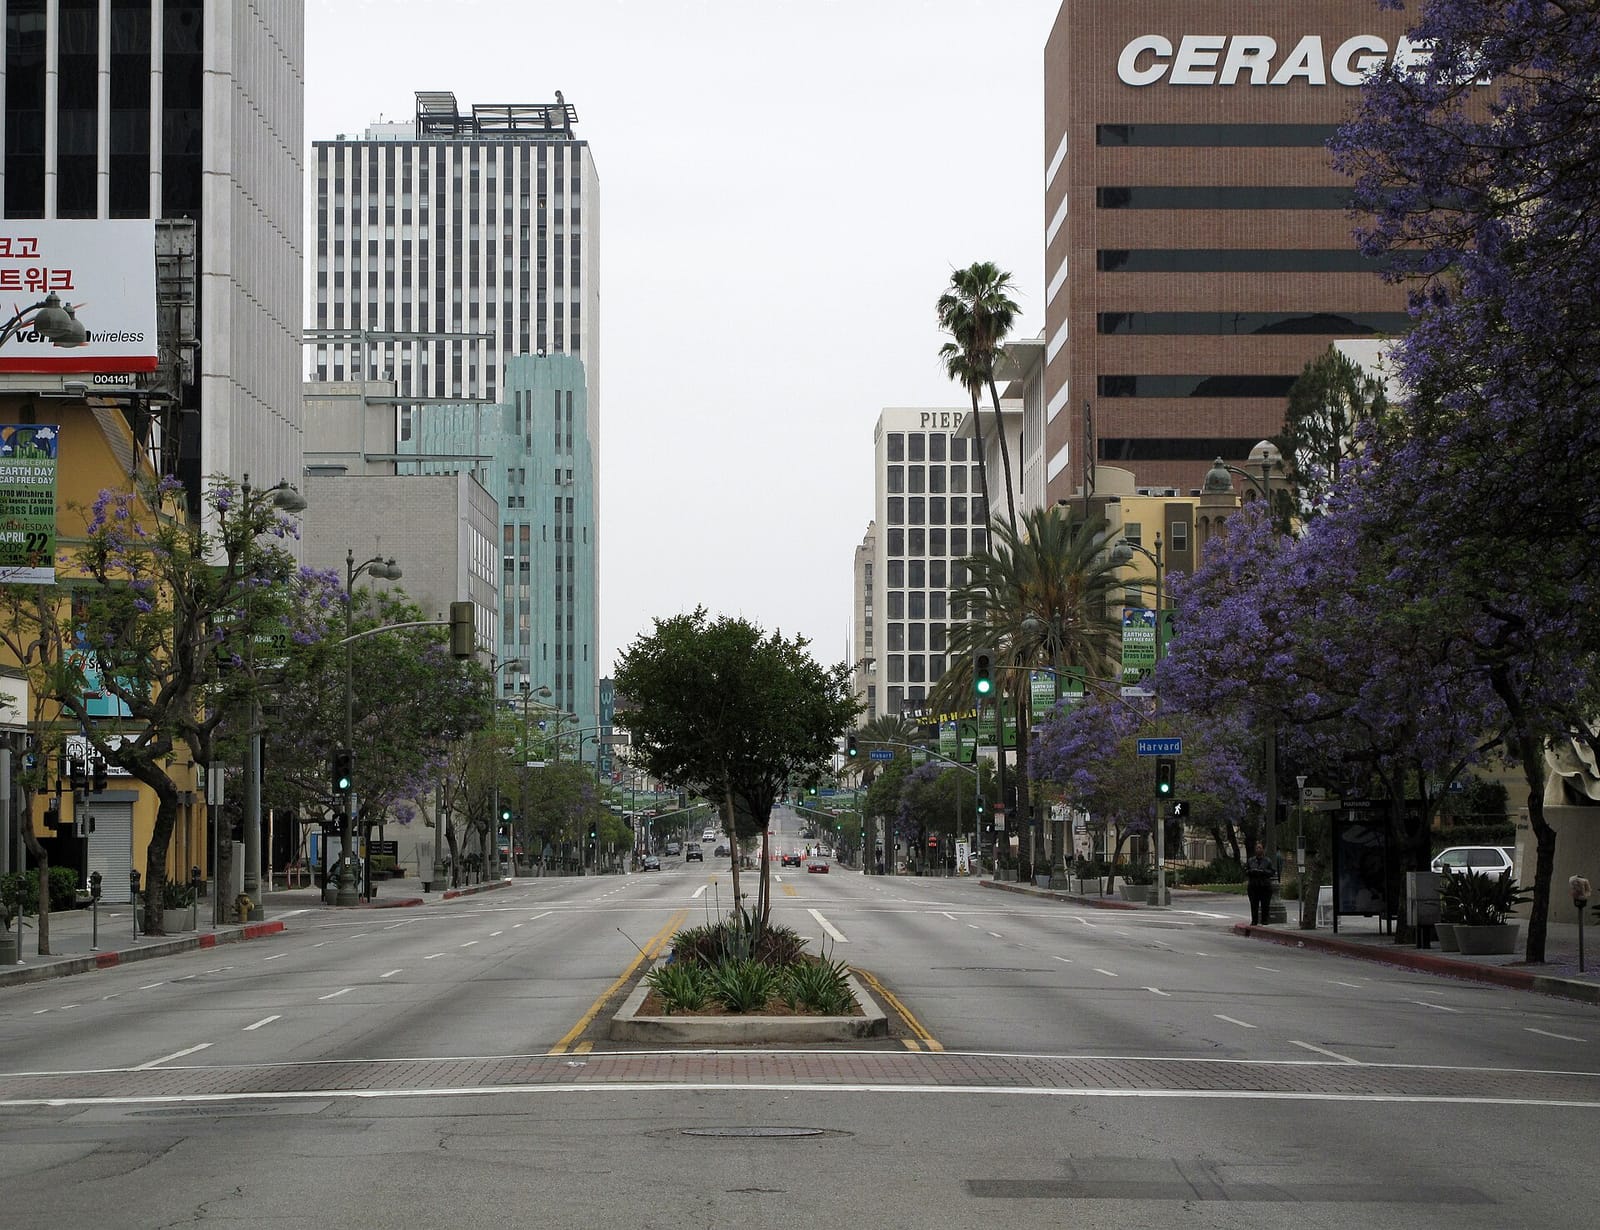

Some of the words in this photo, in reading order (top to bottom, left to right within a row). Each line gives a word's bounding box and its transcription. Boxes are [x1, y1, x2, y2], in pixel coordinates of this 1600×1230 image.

[92, 330, 144, 343] wireless
[94, 375, 129, 384] 004141
[0, 467, 31, 476] EARTH
[34, 467, 54, 476] DAY
[0, 476, 15, 484] CAR
[16, 476, 36, 484] FREE
[16, 489, 44, 498] Wilshire
[29, 505, 54, 515] Lawn
[0, 532, 25, 543] APRIL
[26, 532, 48, 553] 22
[272, 634, 286, 648] 22
[1139, 742, 1180, 752] Harvard
